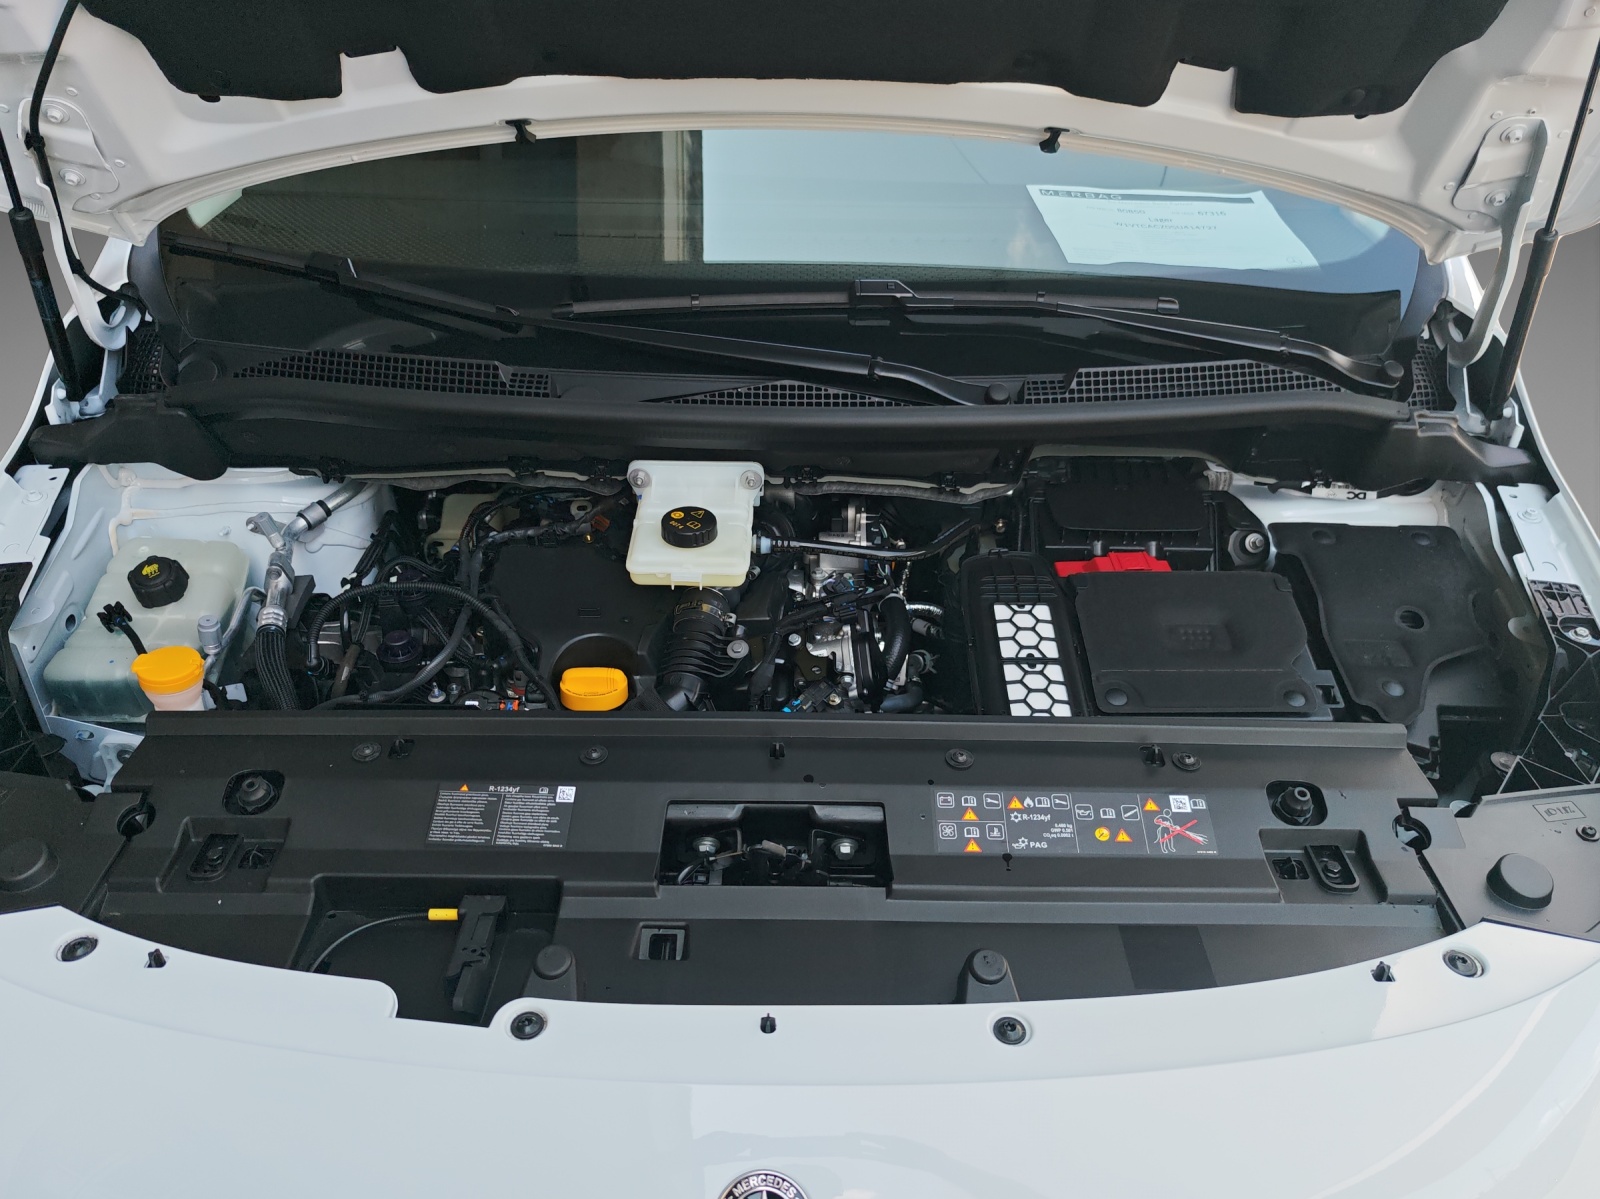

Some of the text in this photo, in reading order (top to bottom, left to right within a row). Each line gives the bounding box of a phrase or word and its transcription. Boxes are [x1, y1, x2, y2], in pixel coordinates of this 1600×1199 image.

[1041, 189, 1122, 200] MERBAG
[488, 786, 520, 794] R-1234yf
[1022, 814, 1051, 822] R-1234yf
[1029, 841, 1048, 849] PAG
[732, 1175, 797, 1198] MERCEDES
